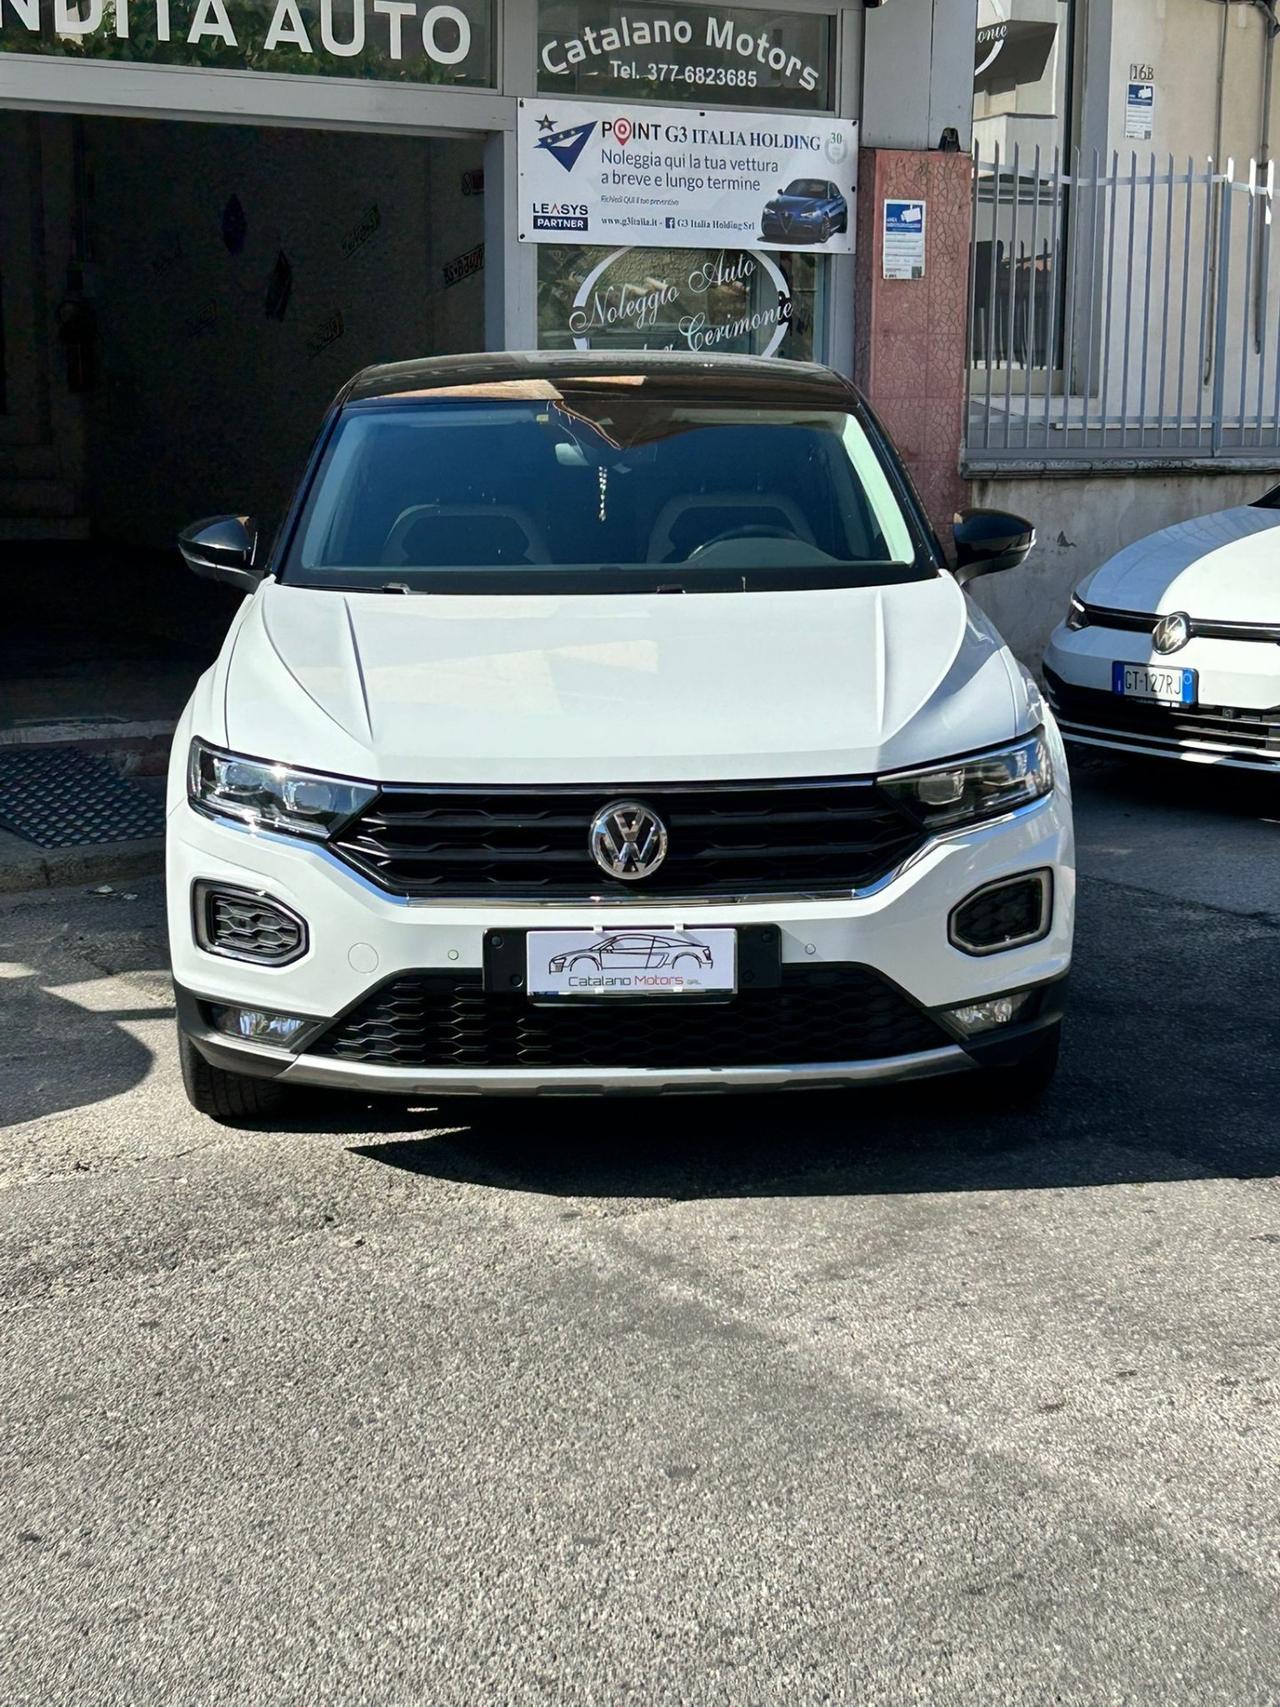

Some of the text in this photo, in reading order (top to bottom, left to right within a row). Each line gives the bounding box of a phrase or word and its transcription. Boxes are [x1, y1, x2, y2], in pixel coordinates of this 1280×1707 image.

[264, 0, 471, 65] AUTO
[541, 16, 820, 91] Catalano Motors
[610, 60, 640, 80] Tel.
[602, 118, 820, 151] POINT G3 ITALIA HOLDING
[601, 148, 779, 172] Noleggia qui la tua vettura
[601, 169, 760, 191] a breve e lungo termine
[532, 202, 588, 215] LEASYS
[537, 218, 584, 229] PARTNER
[569, 249, 757, 333] Noleggio Auto
[678, 296, 793, 352] Cerimonie
[568, 975, 631, 986] Catalano
[634, 975, 684, 986] Motors
